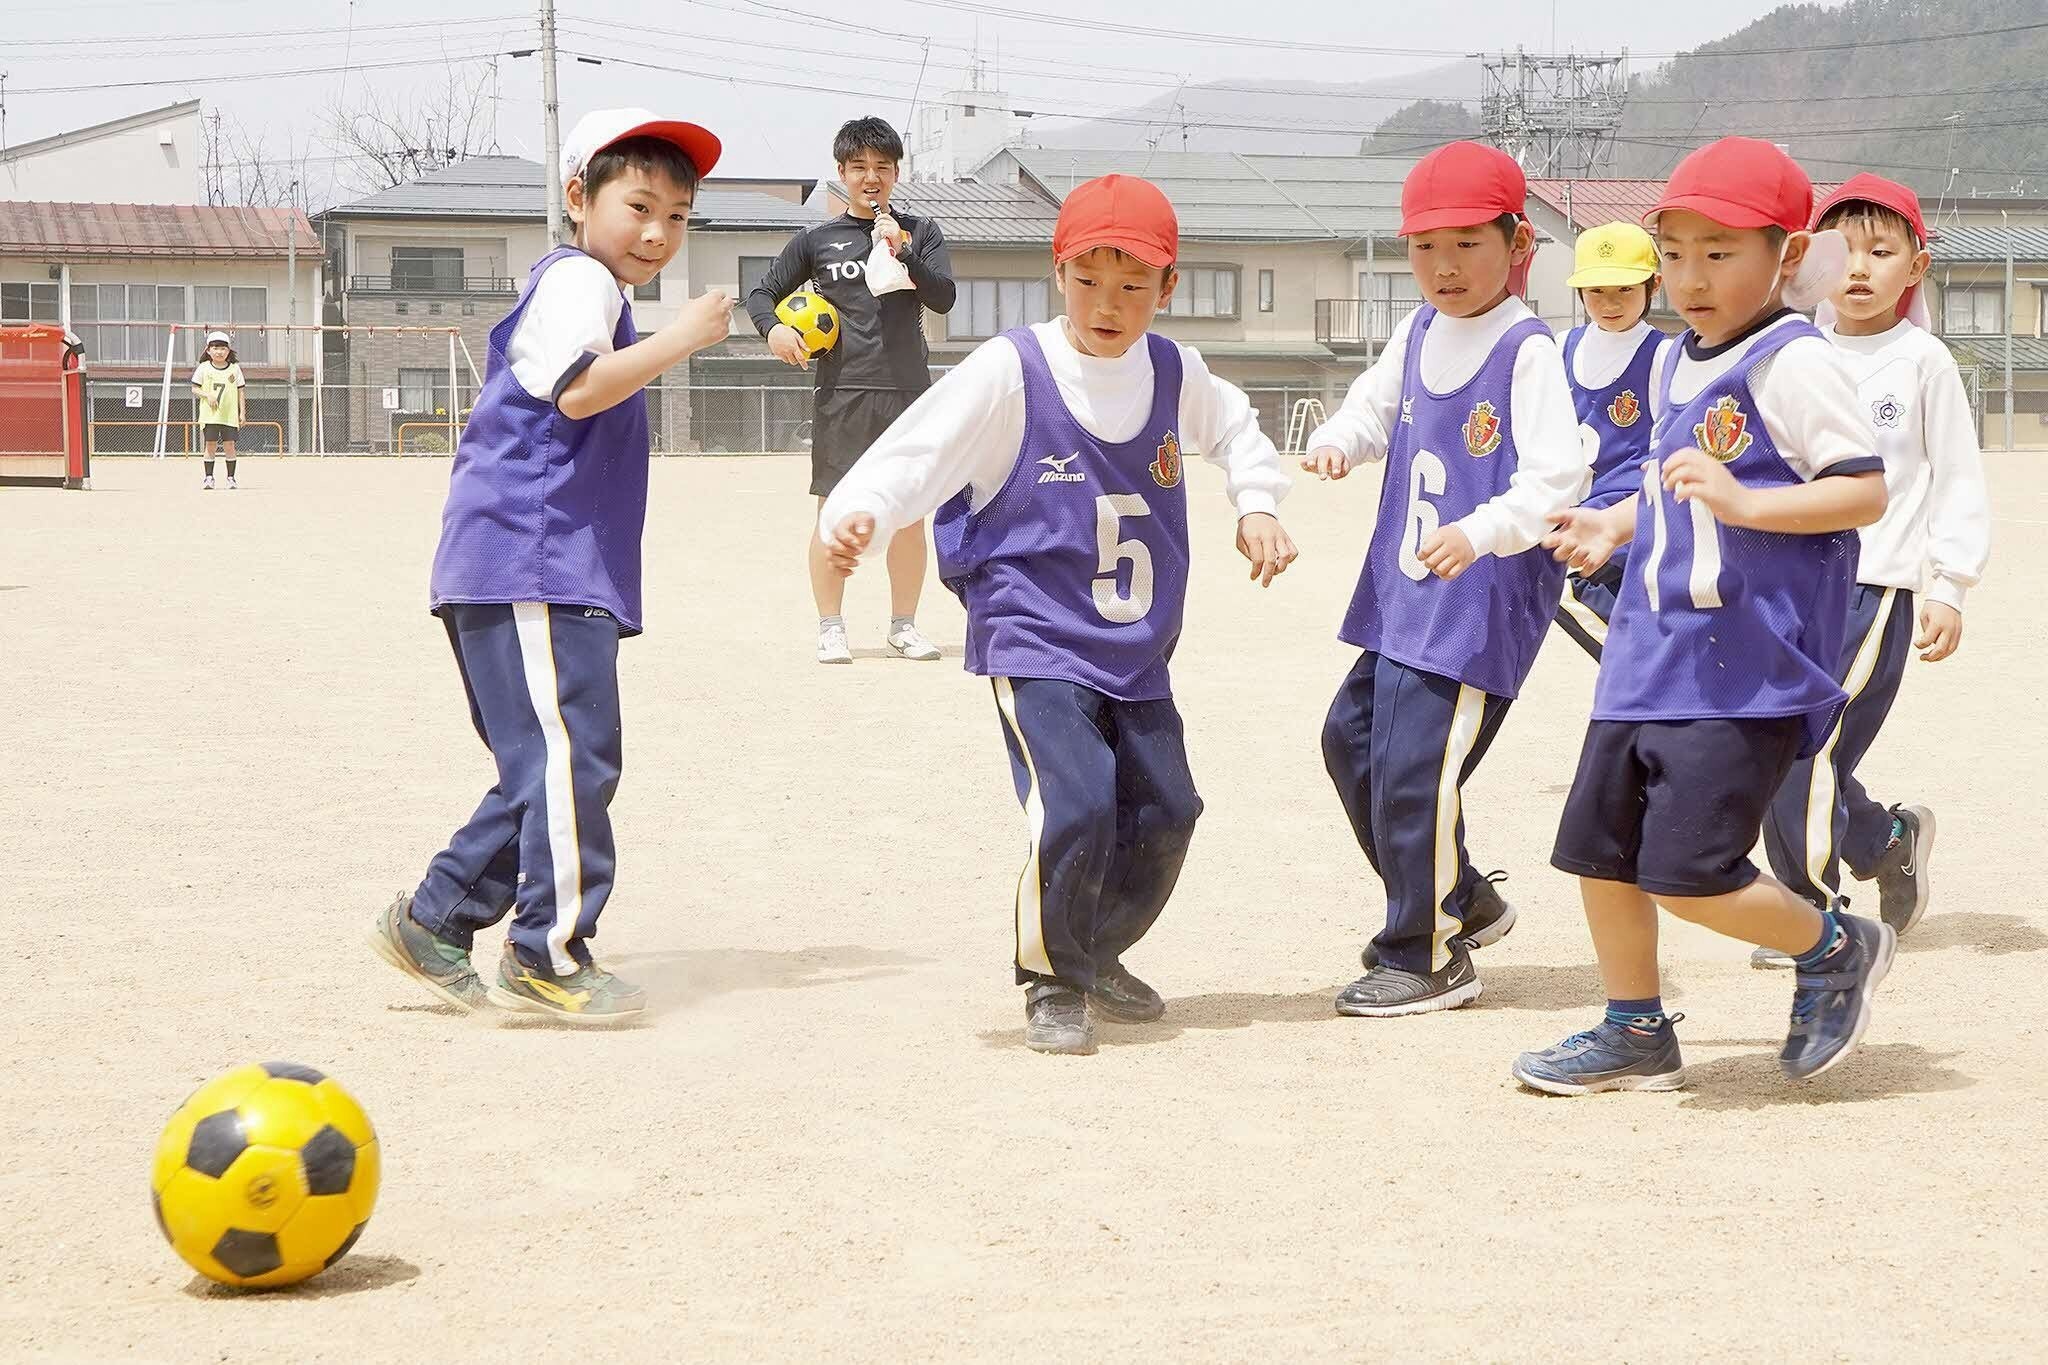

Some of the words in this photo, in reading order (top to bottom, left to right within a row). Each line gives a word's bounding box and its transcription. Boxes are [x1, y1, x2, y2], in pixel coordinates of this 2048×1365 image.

[128, 389, 139, 404] 2
[1092, 493, 1154, 623] 5
[1399, 449, 1447, 581] 6
